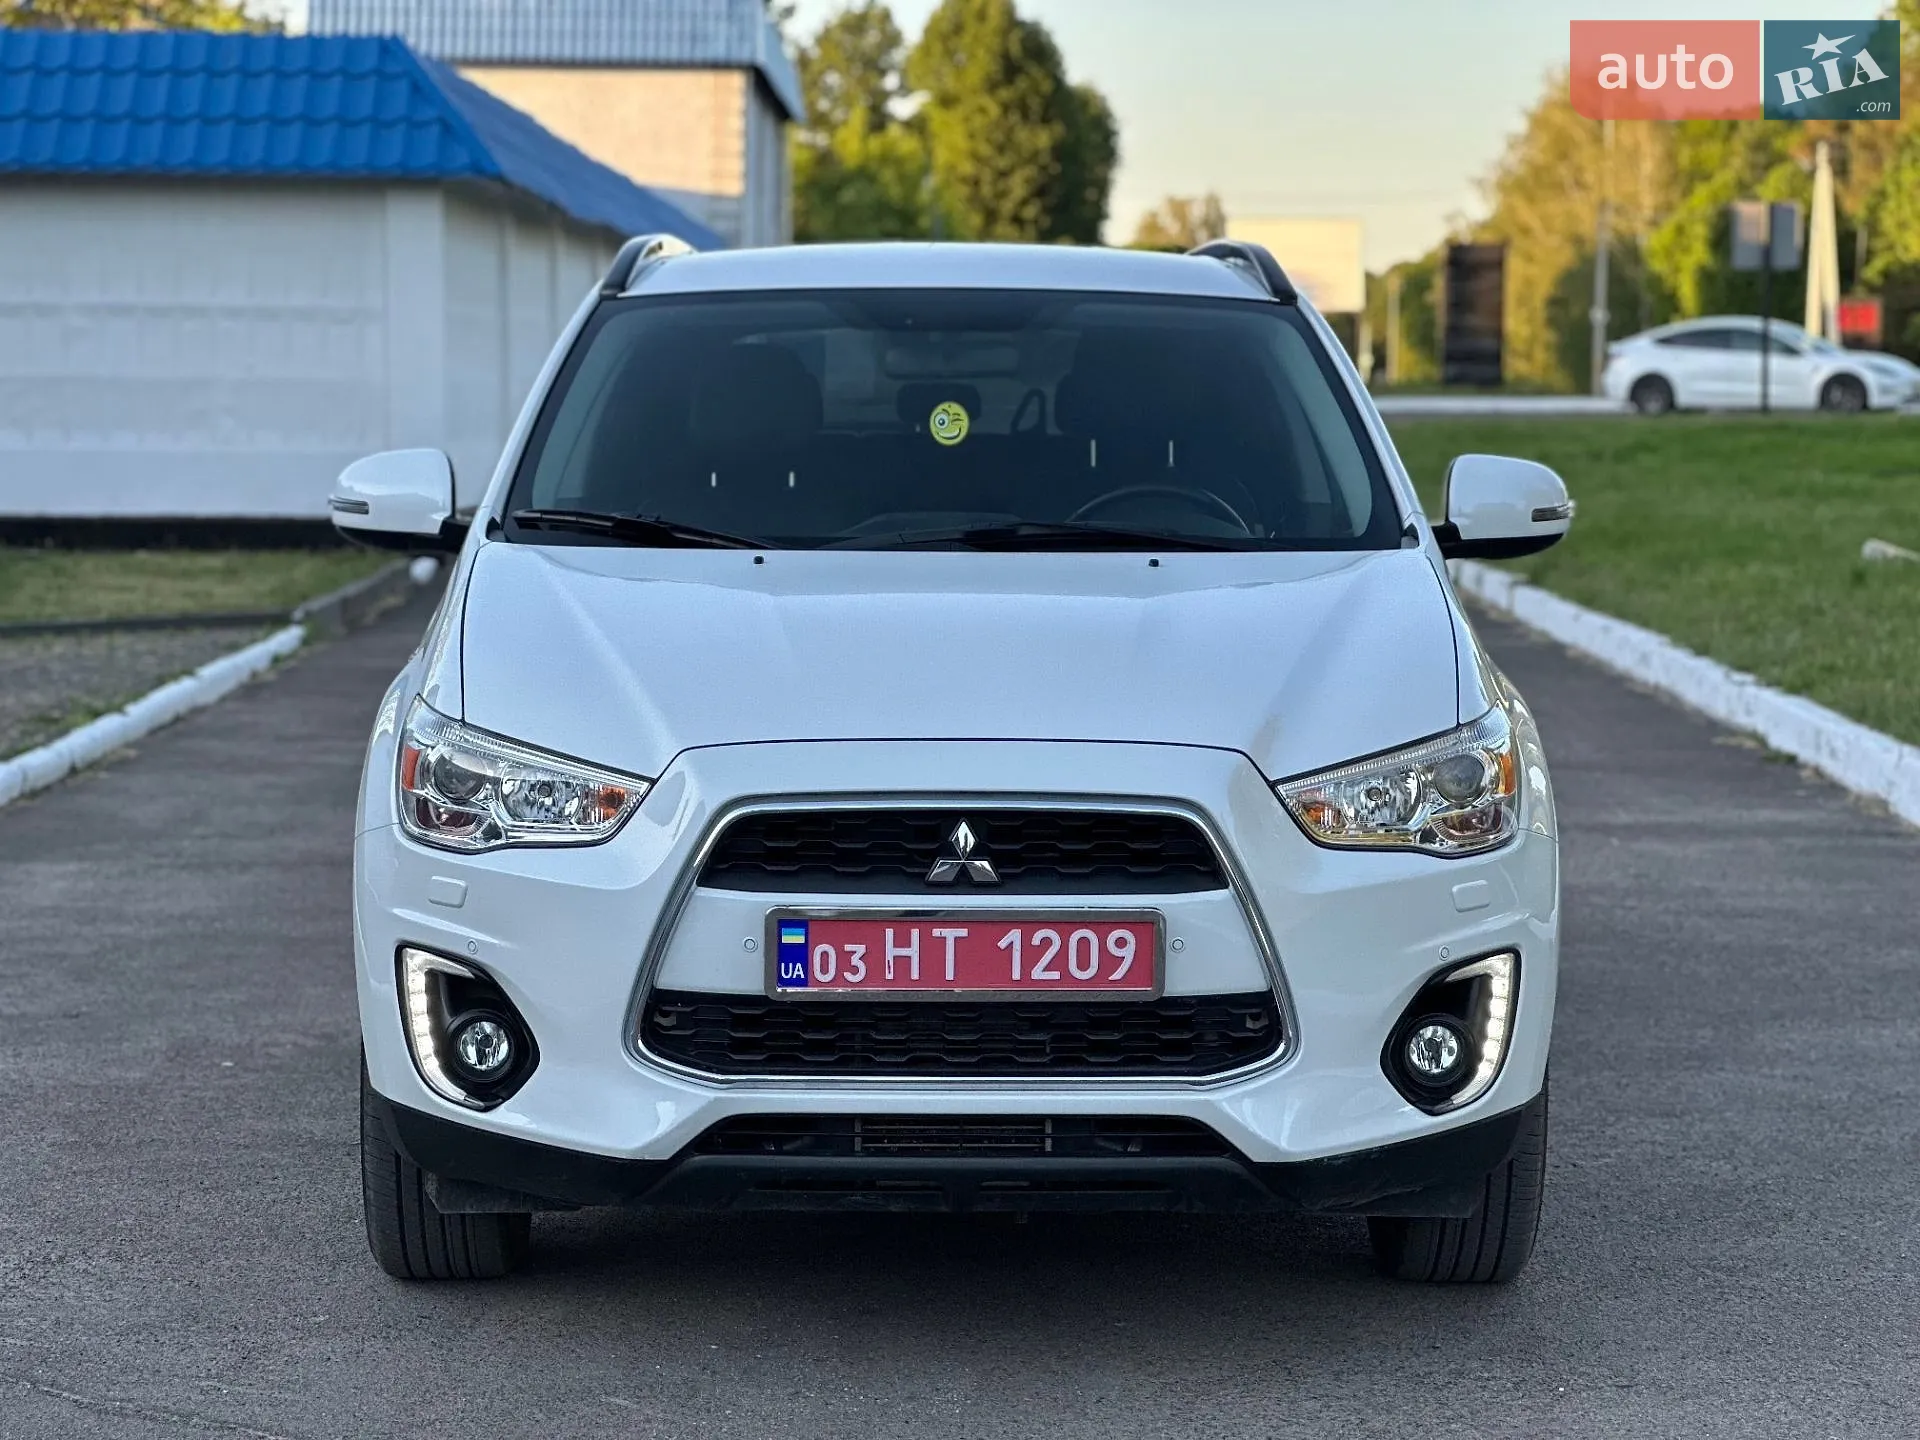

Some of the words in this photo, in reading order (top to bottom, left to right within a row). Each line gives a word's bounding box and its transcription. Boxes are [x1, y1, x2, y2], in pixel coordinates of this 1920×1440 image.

[781, 963, 804, 979] UA
[813, 944, 867, 983] 03
[885, 928, 968, 981] HT
[997, 928, 1136, 981] 1209
